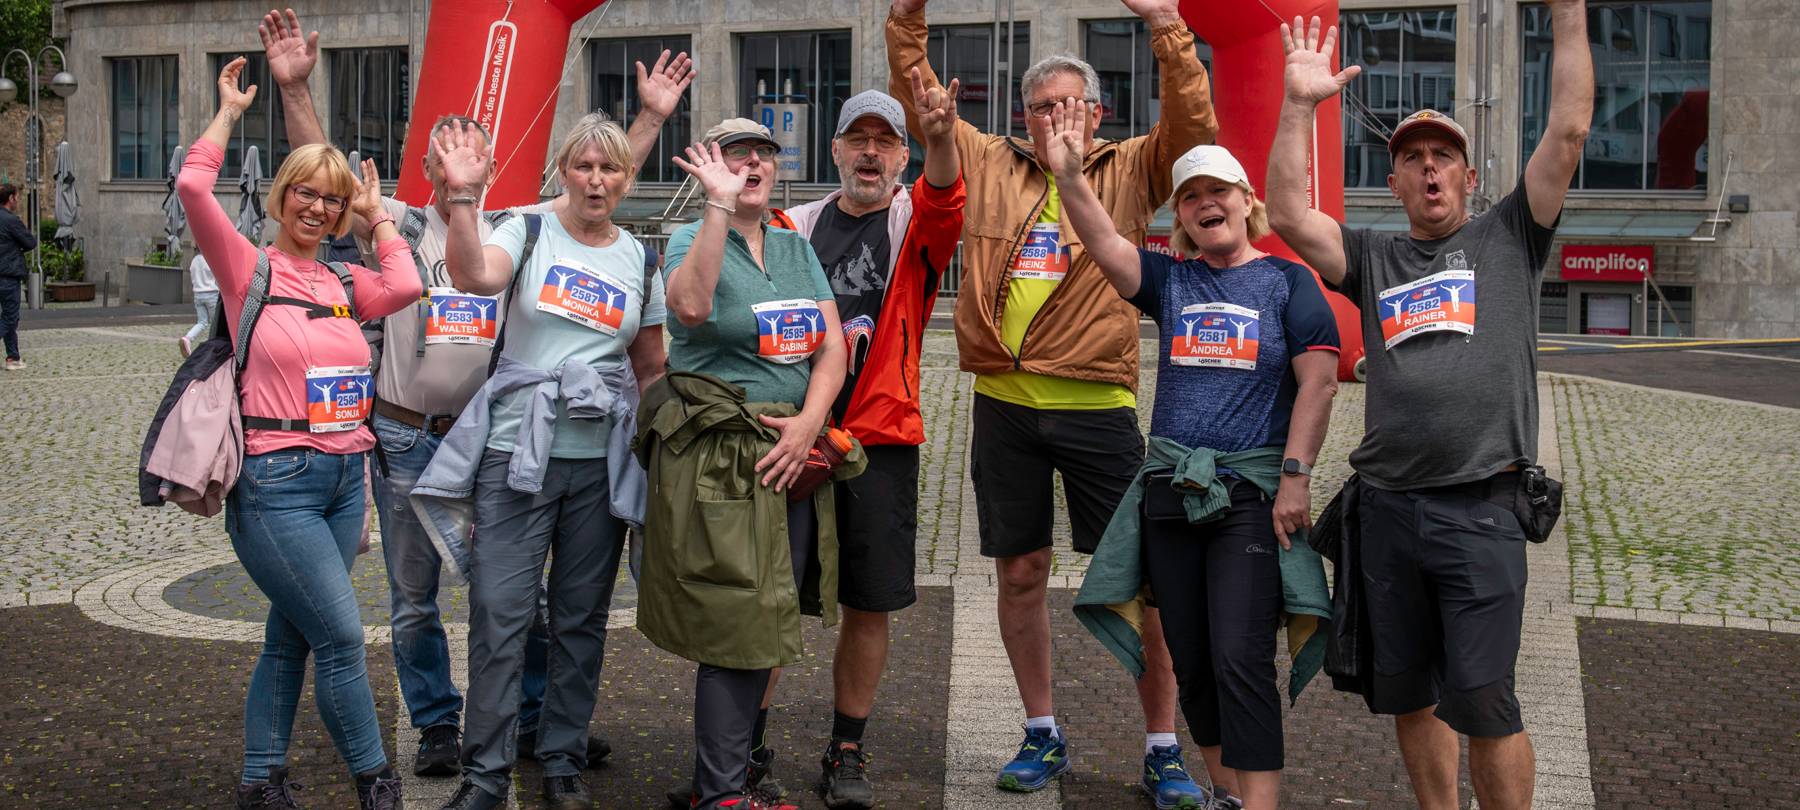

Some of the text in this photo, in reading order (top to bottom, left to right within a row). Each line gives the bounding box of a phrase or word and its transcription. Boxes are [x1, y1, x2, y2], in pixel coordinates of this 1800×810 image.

[481, 33, 508, 131] 0% die beste Musik.
[1021, 248, 1047, 258] 2588
[1147, 242, 1179, 258] lifon
[1018, 260, 1047, 269] HEINZ
[1564, 252, 1649, 274] amplifon
[571, 287, 599, 304] 2587
[562, 298, 600, 319] MONIKA
[1409, 298, 1440, 315] 2582
[446, 312, 472, 323] 2583
[1404, 310, 1447, 328] RAINER
[439, 324, 479, 334] WALTER
[783, 327, 805, 340] 2585
[1199, 331, 1226, 343] 2581
[779, 341, 808, 352] SABINE
[1190, 345, 1233, 356] ANDREA
[337, 394, 358, 407] 2584
[335, 409, 360, 419] SONJA
